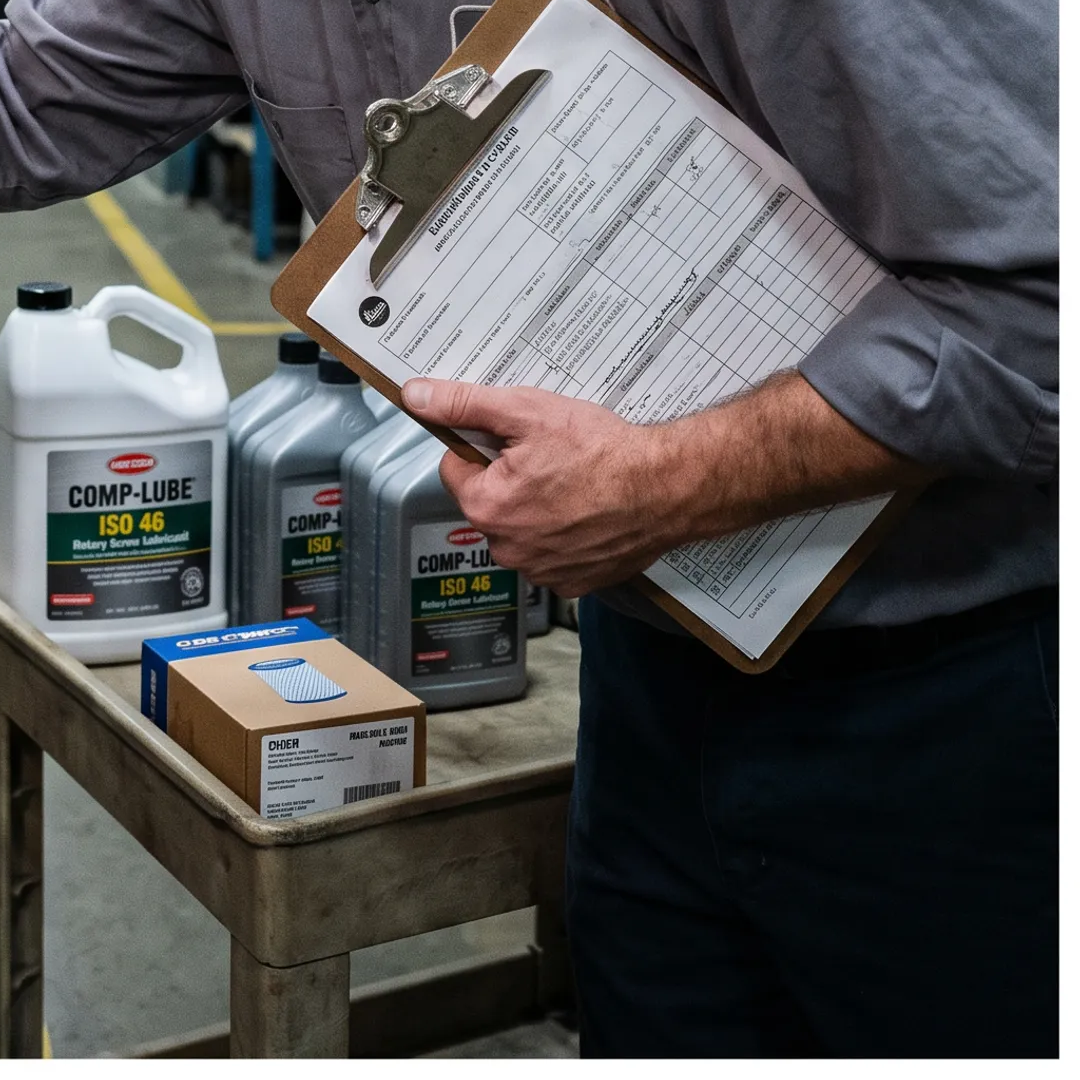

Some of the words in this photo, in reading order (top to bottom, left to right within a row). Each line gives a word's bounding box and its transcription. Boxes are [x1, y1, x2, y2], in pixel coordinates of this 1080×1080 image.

[69, 477, 192, 508] COMP-LUBE
[99, 514, 133, 536] ISO
[139, 511, 165, 532] 46
[308, 536, 332, 554] ISO
[440, 577, 466, 596] ISO
[471, 574, 491, 592] 46
